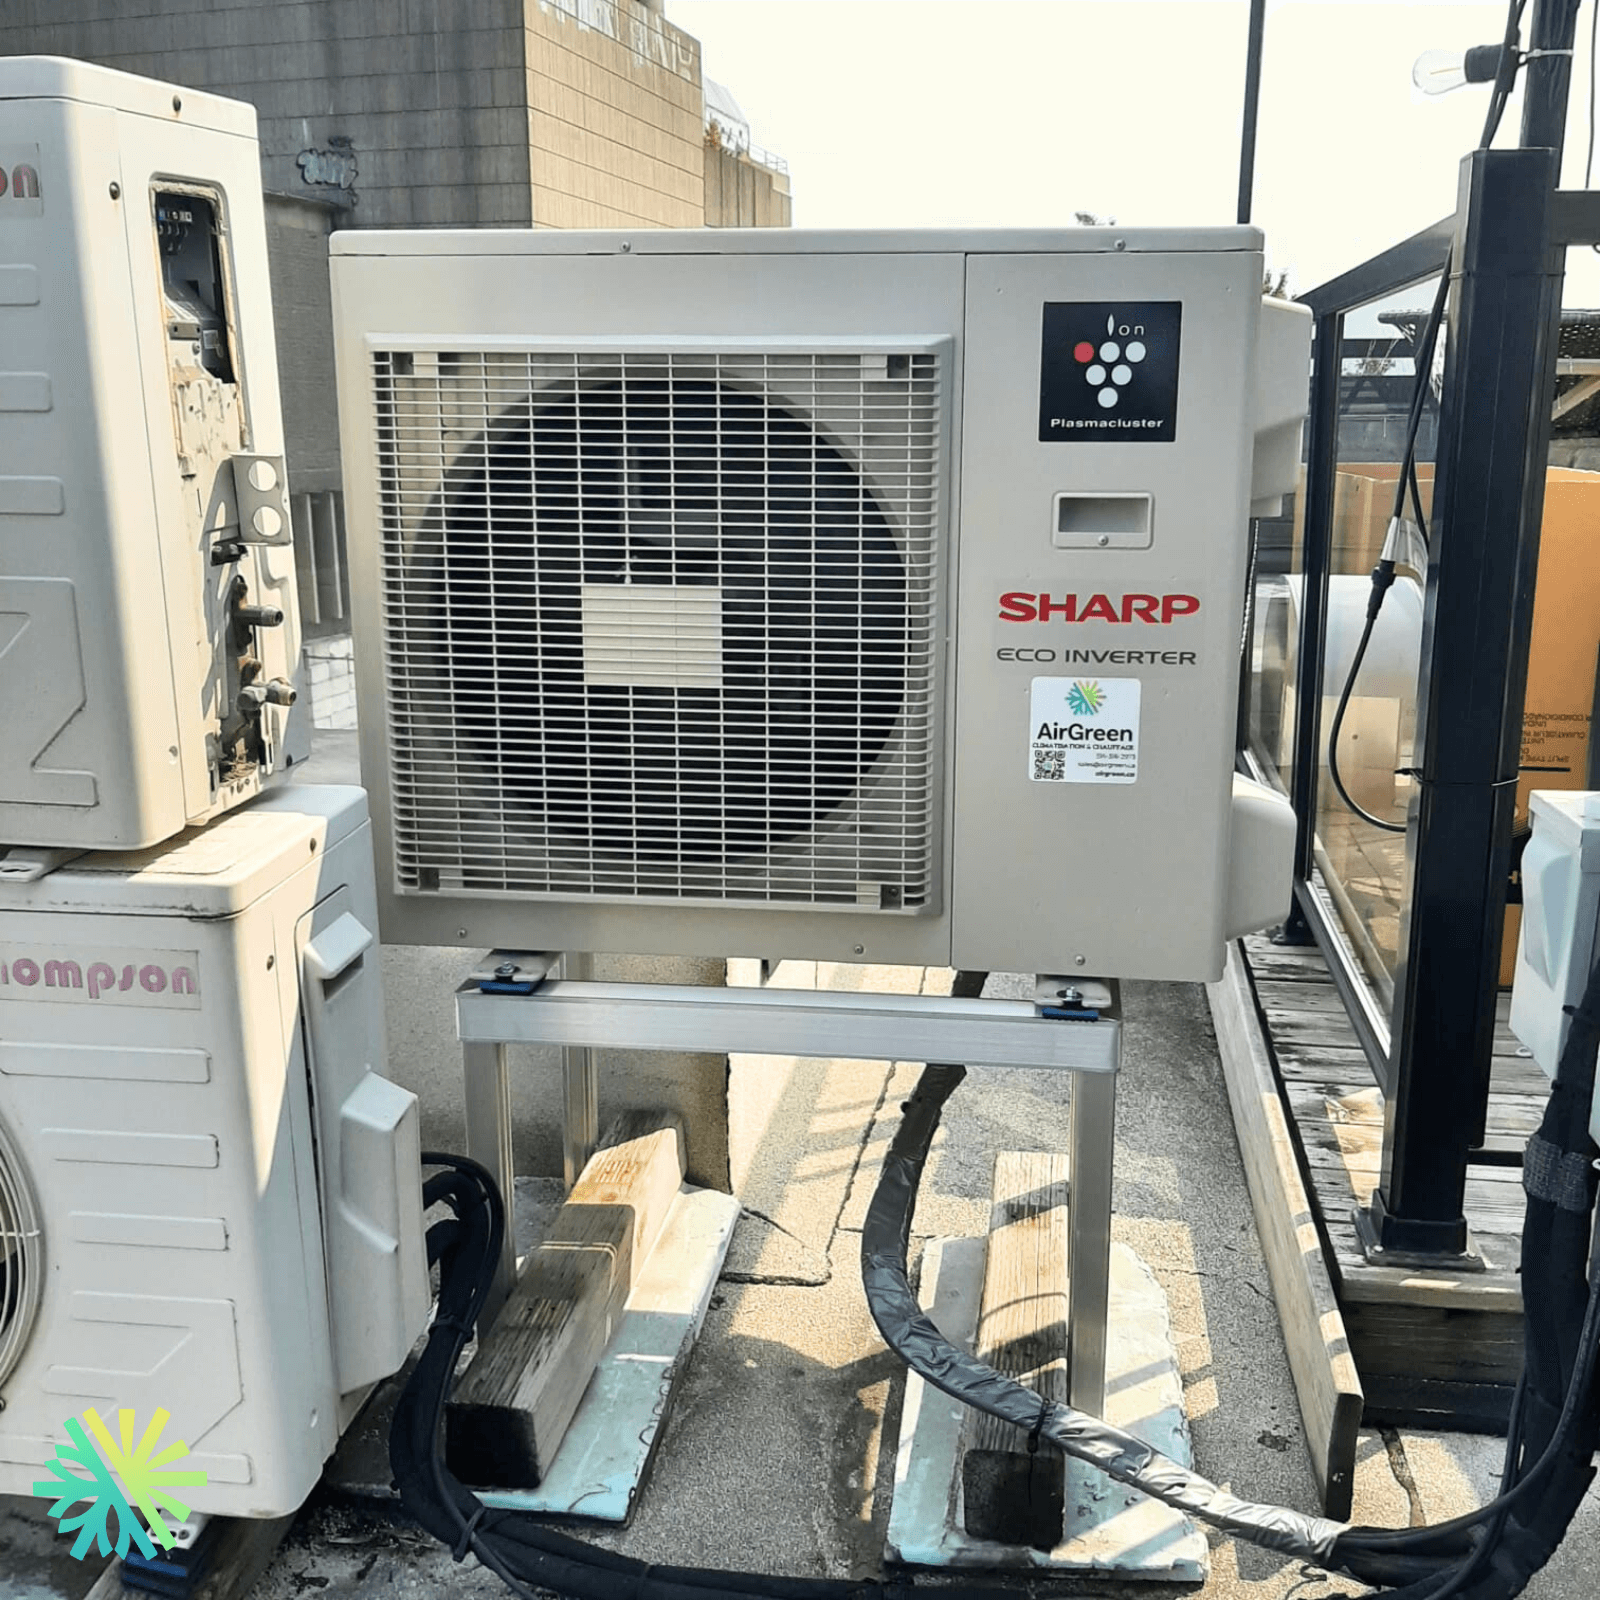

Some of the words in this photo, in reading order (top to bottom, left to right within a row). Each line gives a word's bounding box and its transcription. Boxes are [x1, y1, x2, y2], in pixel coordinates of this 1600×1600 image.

[1050, 418, 1164, 429] Plasmacluster
[998, 592, 1201, 625] SHARP
[996, 647, 1056, 662] ECO
[1065, 649, 1197, 666] INVERTER
[1037, 722, 1133, 742] AirGreen
